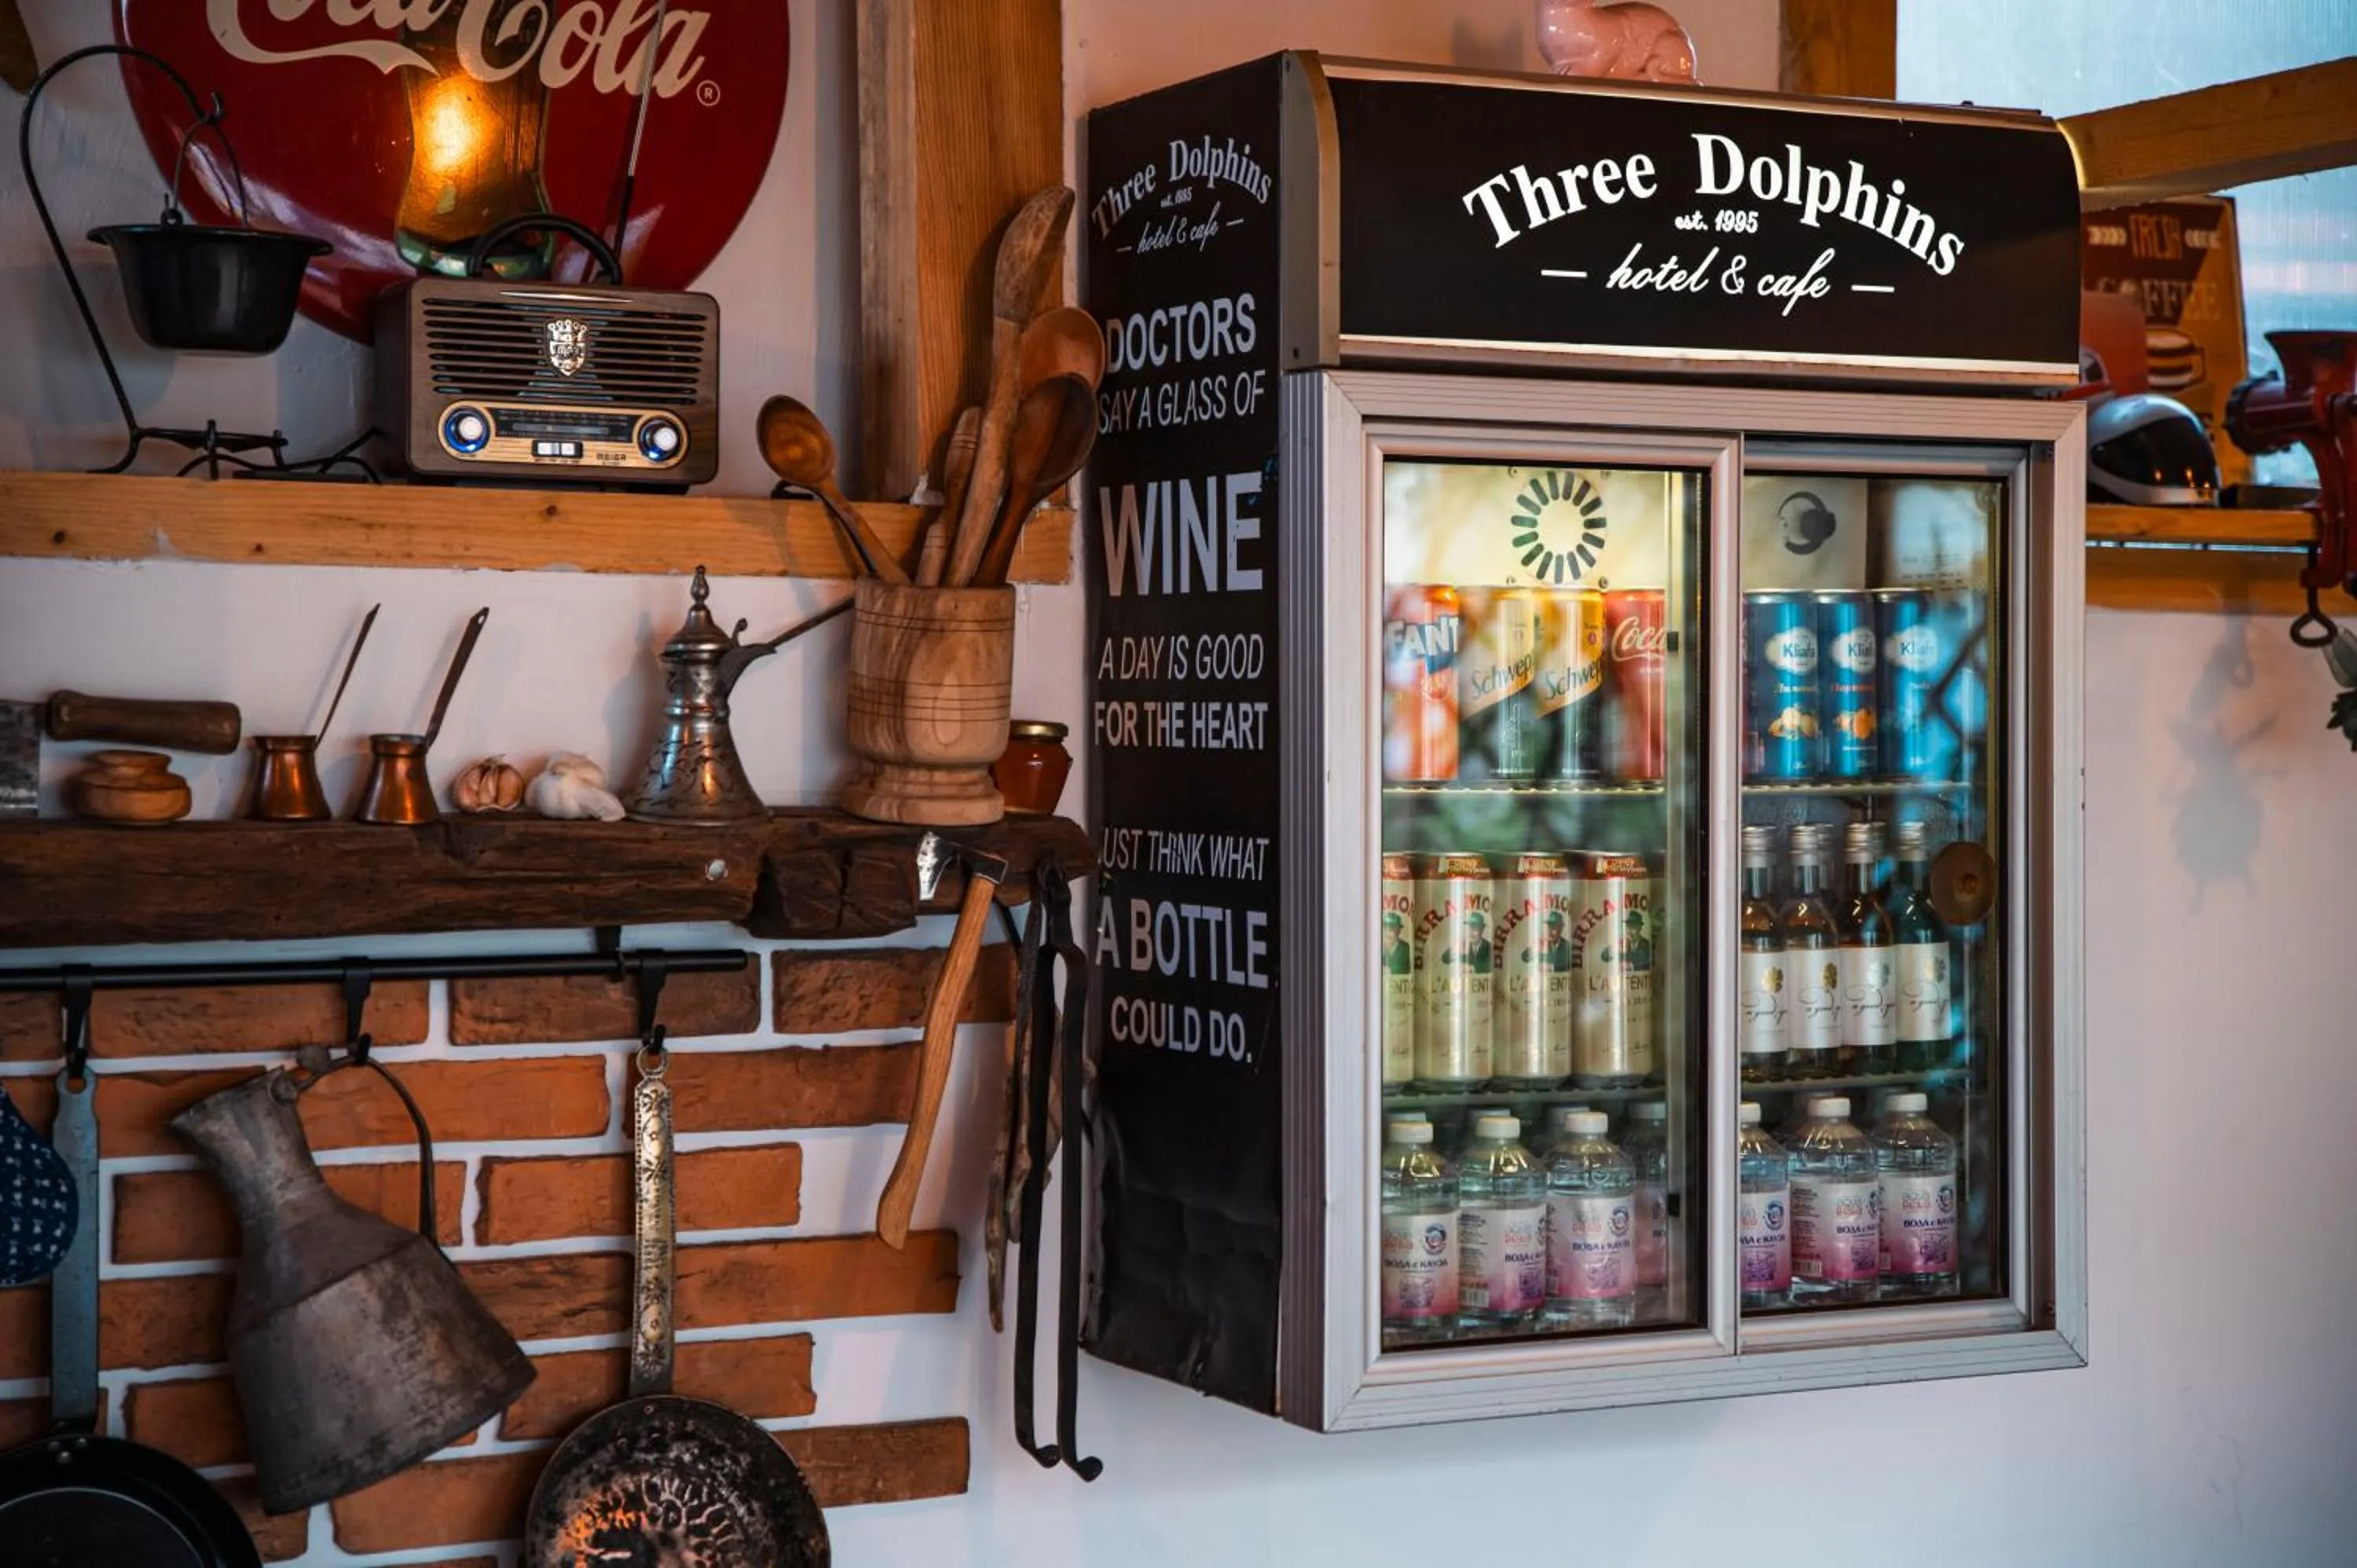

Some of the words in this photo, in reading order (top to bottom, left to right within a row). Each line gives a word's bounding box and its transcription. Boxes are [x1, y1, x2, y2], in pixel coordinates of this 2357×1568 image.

[1091, 163, 1156, 239] Three
[1169, 134, 1273, 205] Dolphins
[1462, 152, 1658, 248] Three
[1691, 133, 1964, 276] Dolphins
[1138, 214, 1176, 254] hotel
[1177, 216, 1187, 244] &
[1190, 200, 1220, 251] cafe
[1675, 210, 1708, 230] est.
[1714, 209, 1759, 233] 1995
[1606, 243, 1720, 290] hotel
[1721, 255, 1744, 294] &
[1757, 247, 1835, 316] cafe
[1106, 293, 1255, 373] DOCTORS
[1099, 388, 1137, 434] SAY
[1138, 387, 1152, 430] A
[1157, 375, 1226, 427] GLASS
[1233, 370, 1266, 416] OF
[1100, 471, 1263, 596] WINE
[1098, 637, 1114, 680] A
[1120, 636, 1164, 680] DAY
[1168, 635, 1189, 680] IS
[1195, 633, 1264, 680] GOOD
[1094, 702, 1138, 746] FOR
[1144, 702, 1185, 748] THE
[1192, 702, 1268, 750] HEART
[1148, 830, 1204, 876] THINK
[1210, 834, 1270, 881] WHAT
[1095, 896, 1120, 969] A
[1131, 898, 1269, 988] BOTTLE
[1111, 996, 1201, 1053] COULD
[1209, 1010, 1252, 1063] DO.
